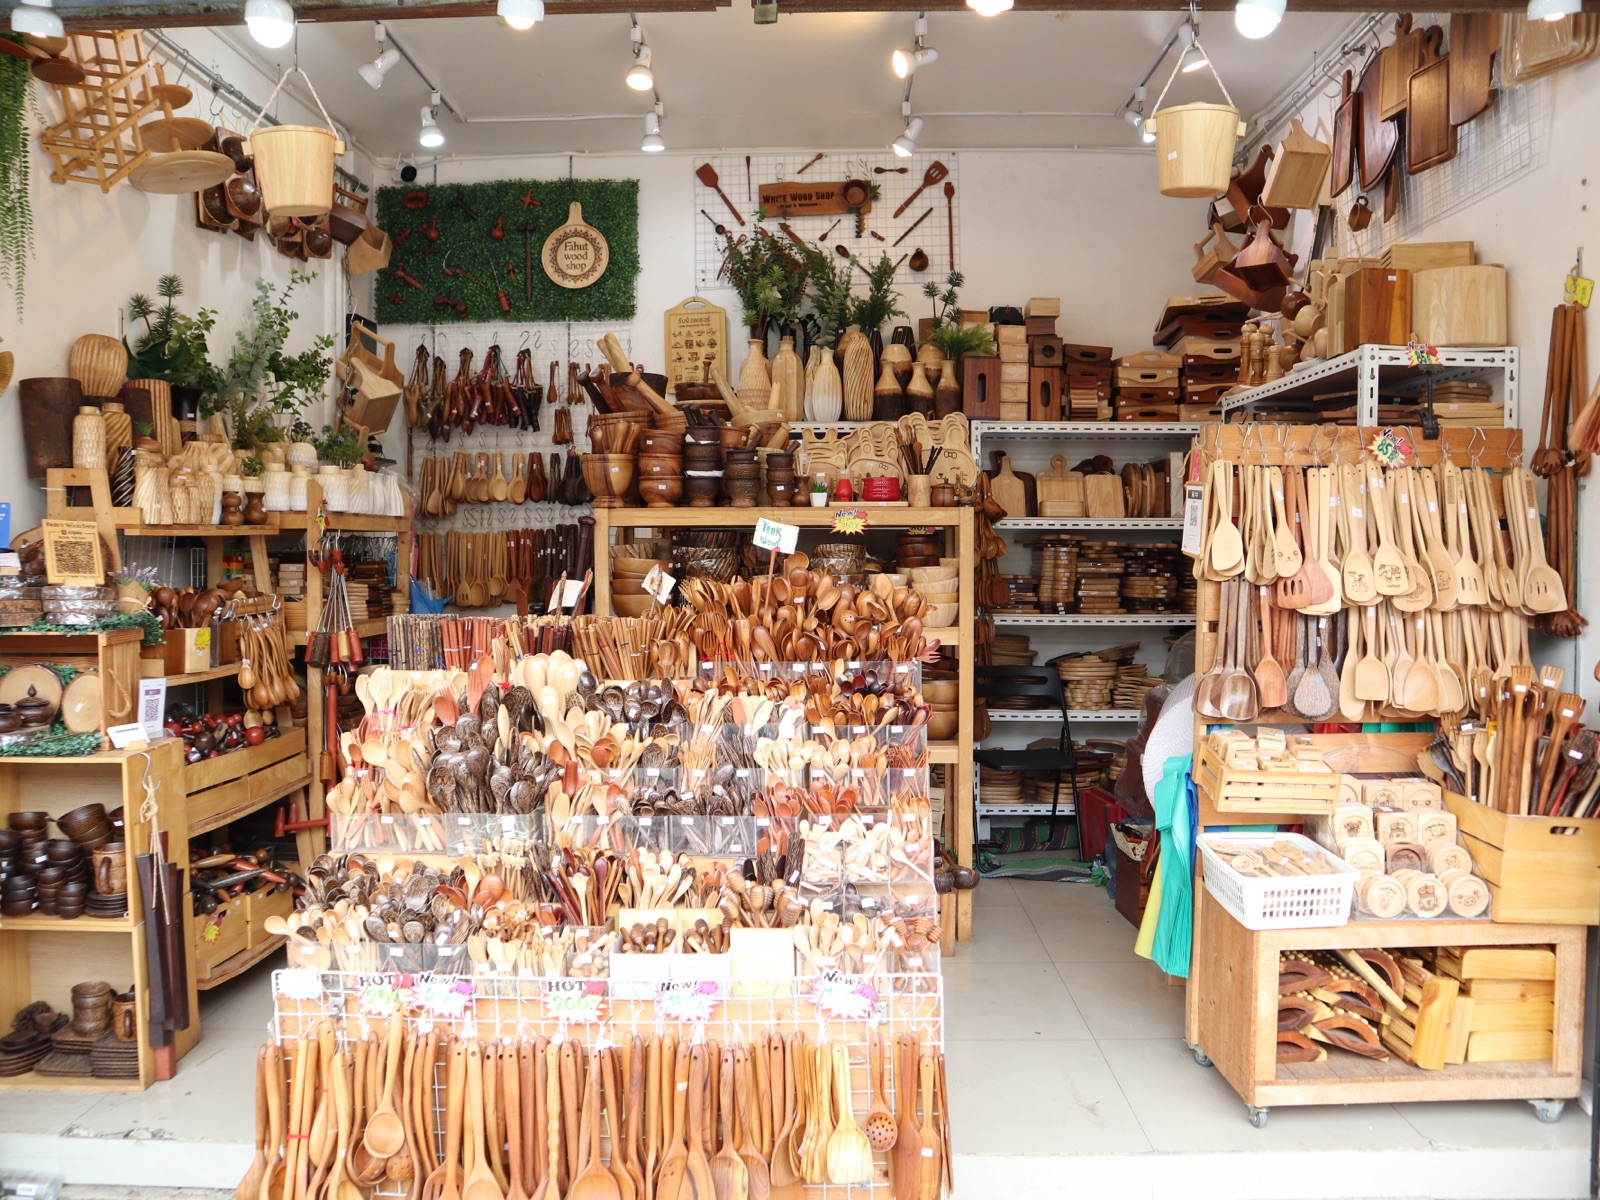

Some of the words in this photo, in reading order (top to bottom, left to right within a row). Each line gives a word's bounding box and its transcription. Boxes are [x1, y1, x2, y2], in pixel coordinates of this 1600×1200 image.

[790, 192, 813, 202] WOOD
[815, 191, 835, 201] SHOP
[564, 241, 589, 251] Fahut
[564, 252, 588, 261] wood
[565, 261, 587, 272] shop
[1381, 428, 1404, 445] New!
[359, 974, 394, 986] HOT
[419, 972, 457, 987] New!
[823, 970, 862, 988] New!
[547, 980, 585, 992] HOT
[661, 980, 698, 992] New!
